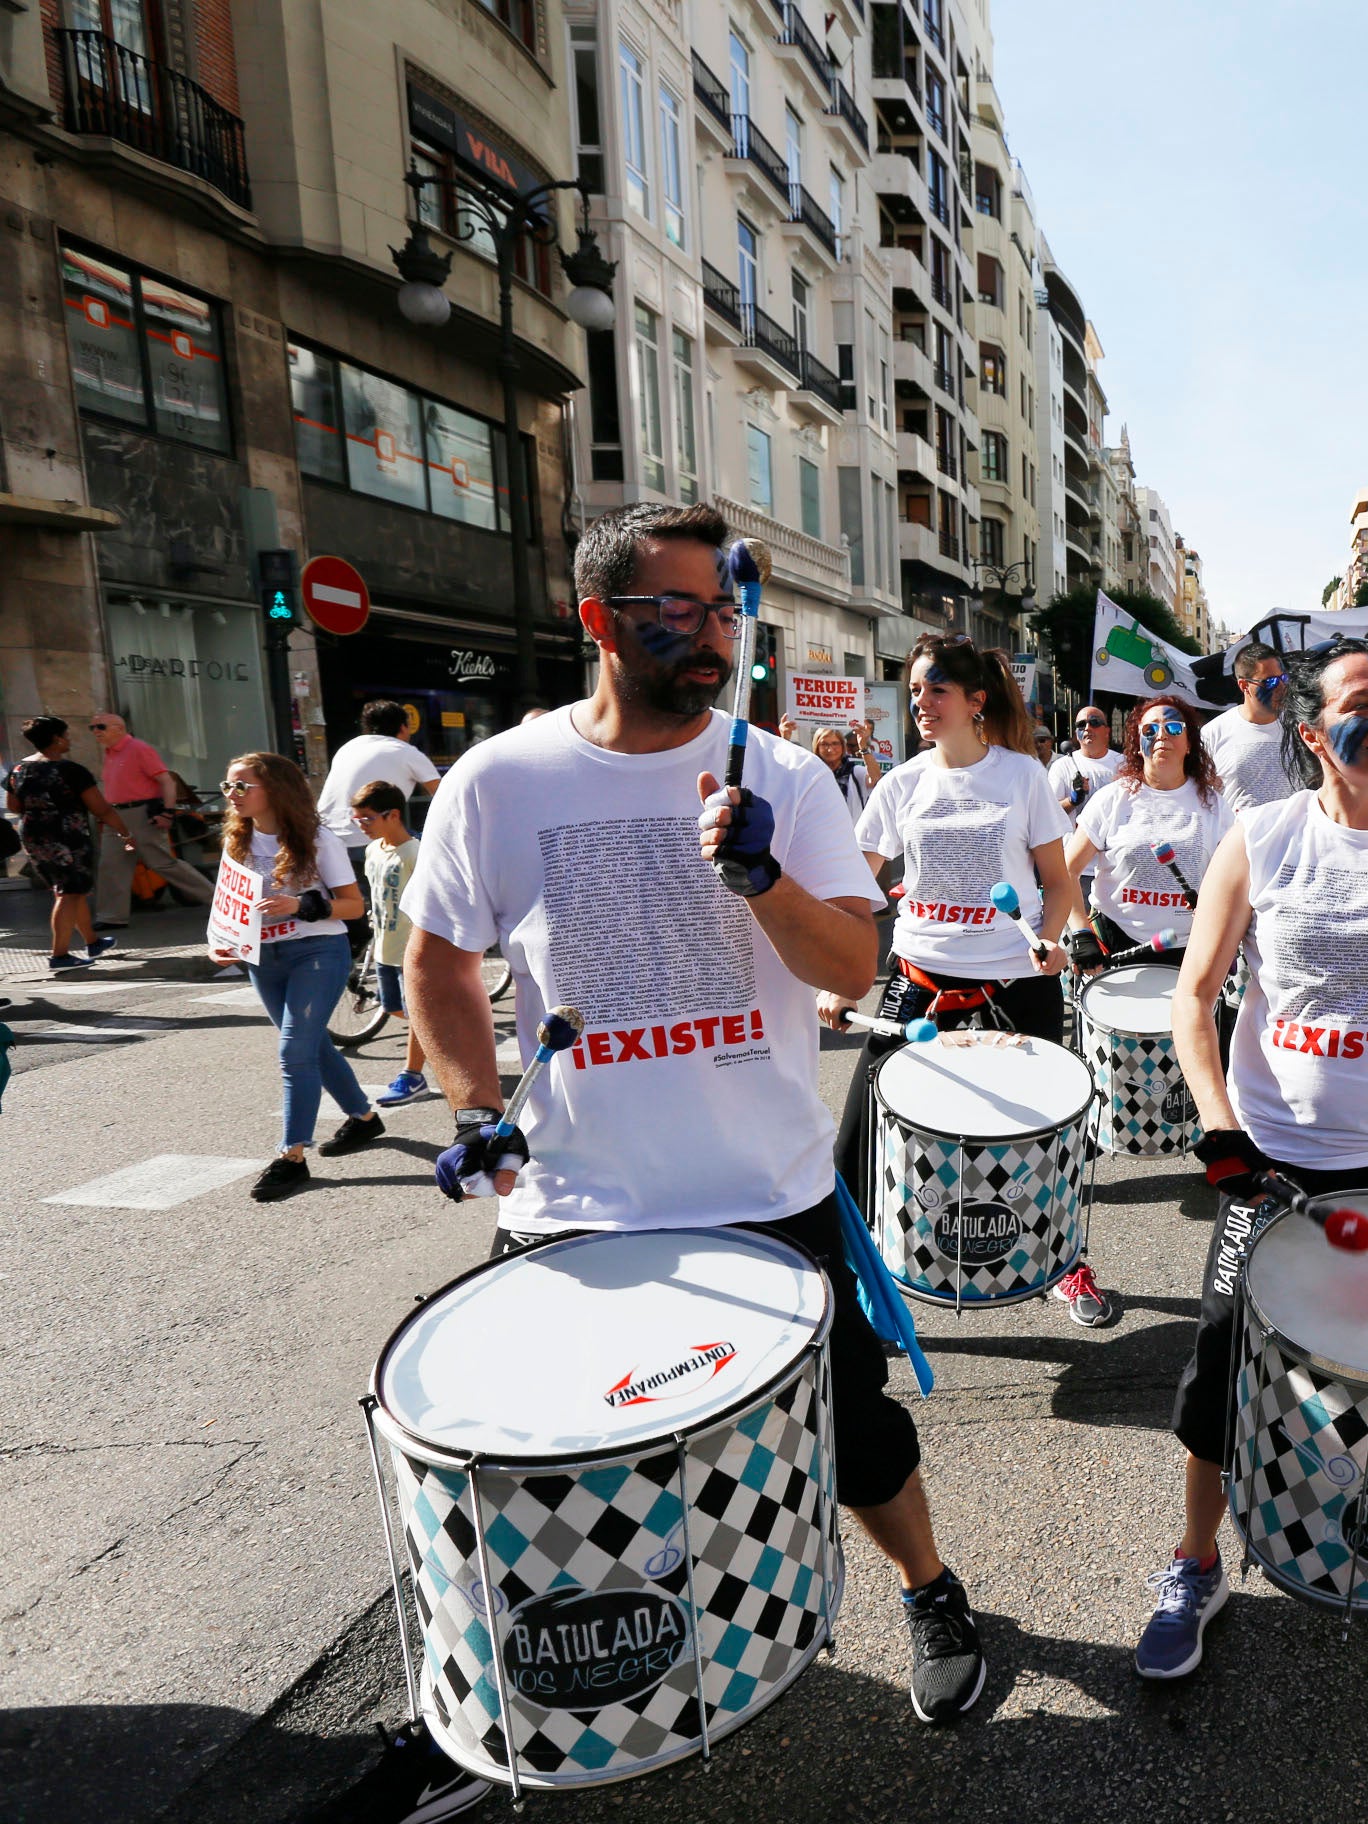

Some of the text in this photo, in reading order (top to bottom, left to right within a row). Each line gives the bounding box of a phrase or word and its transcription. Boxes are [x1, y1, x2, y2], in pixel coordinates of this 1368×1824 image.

[449, 650, 496, 676] Kiehl's
[793, 677, 858, 694] TERUEL
[796, 693, 855, 710] EXISTE
[908, 900, 997, 925] ¡EXISTE!
[572, 1009, 764, 1070] ¡EXISTE!
[713, 1047, 771, 1064] #SalvemosTeruel
[942, 1213, 1018, 1238] BATUCADA
[514, 1602, 680, 1664] BATUCADA
